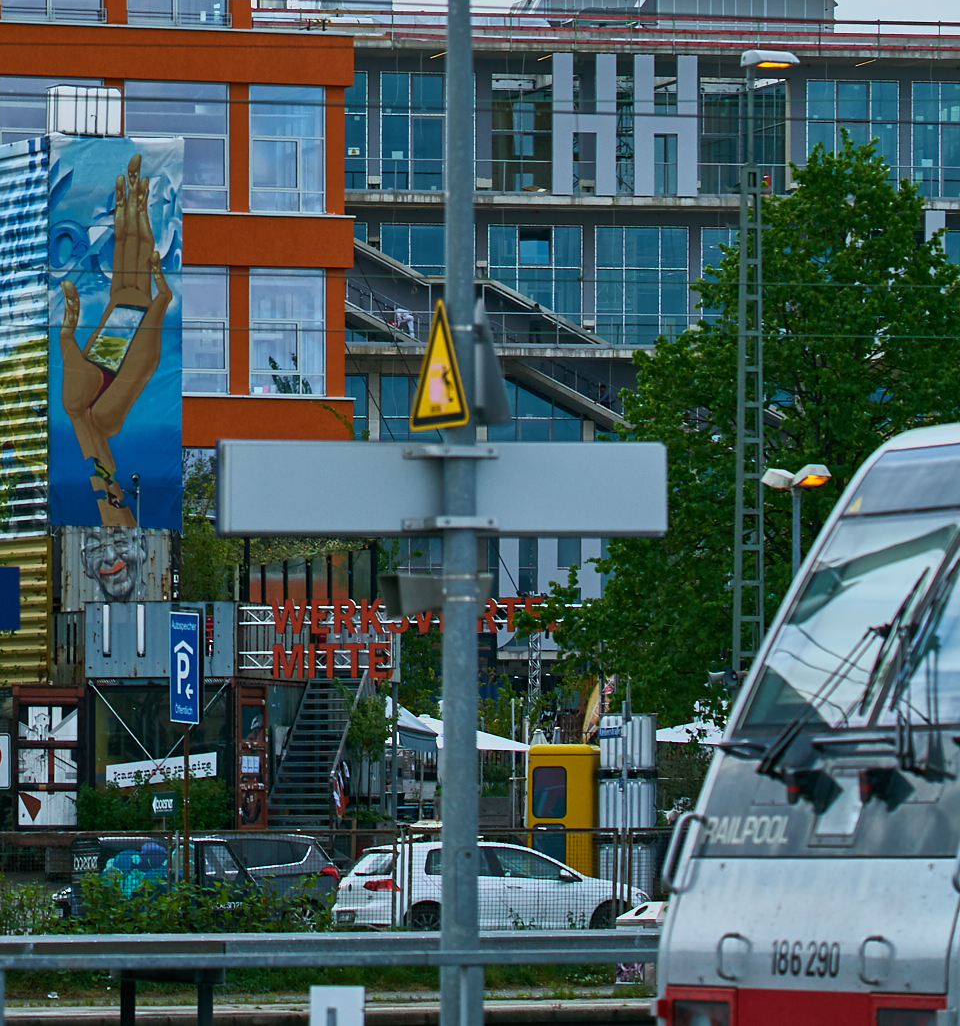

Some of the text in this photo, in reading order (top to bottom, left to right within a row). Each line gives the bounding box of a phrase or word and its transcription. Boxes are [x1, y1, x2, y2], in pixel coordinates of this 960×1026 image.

[177, 652, 190, 695] P
[273, 643, 388, 679] MITTE
[701, 815, 789, 845] RAILPOOL
